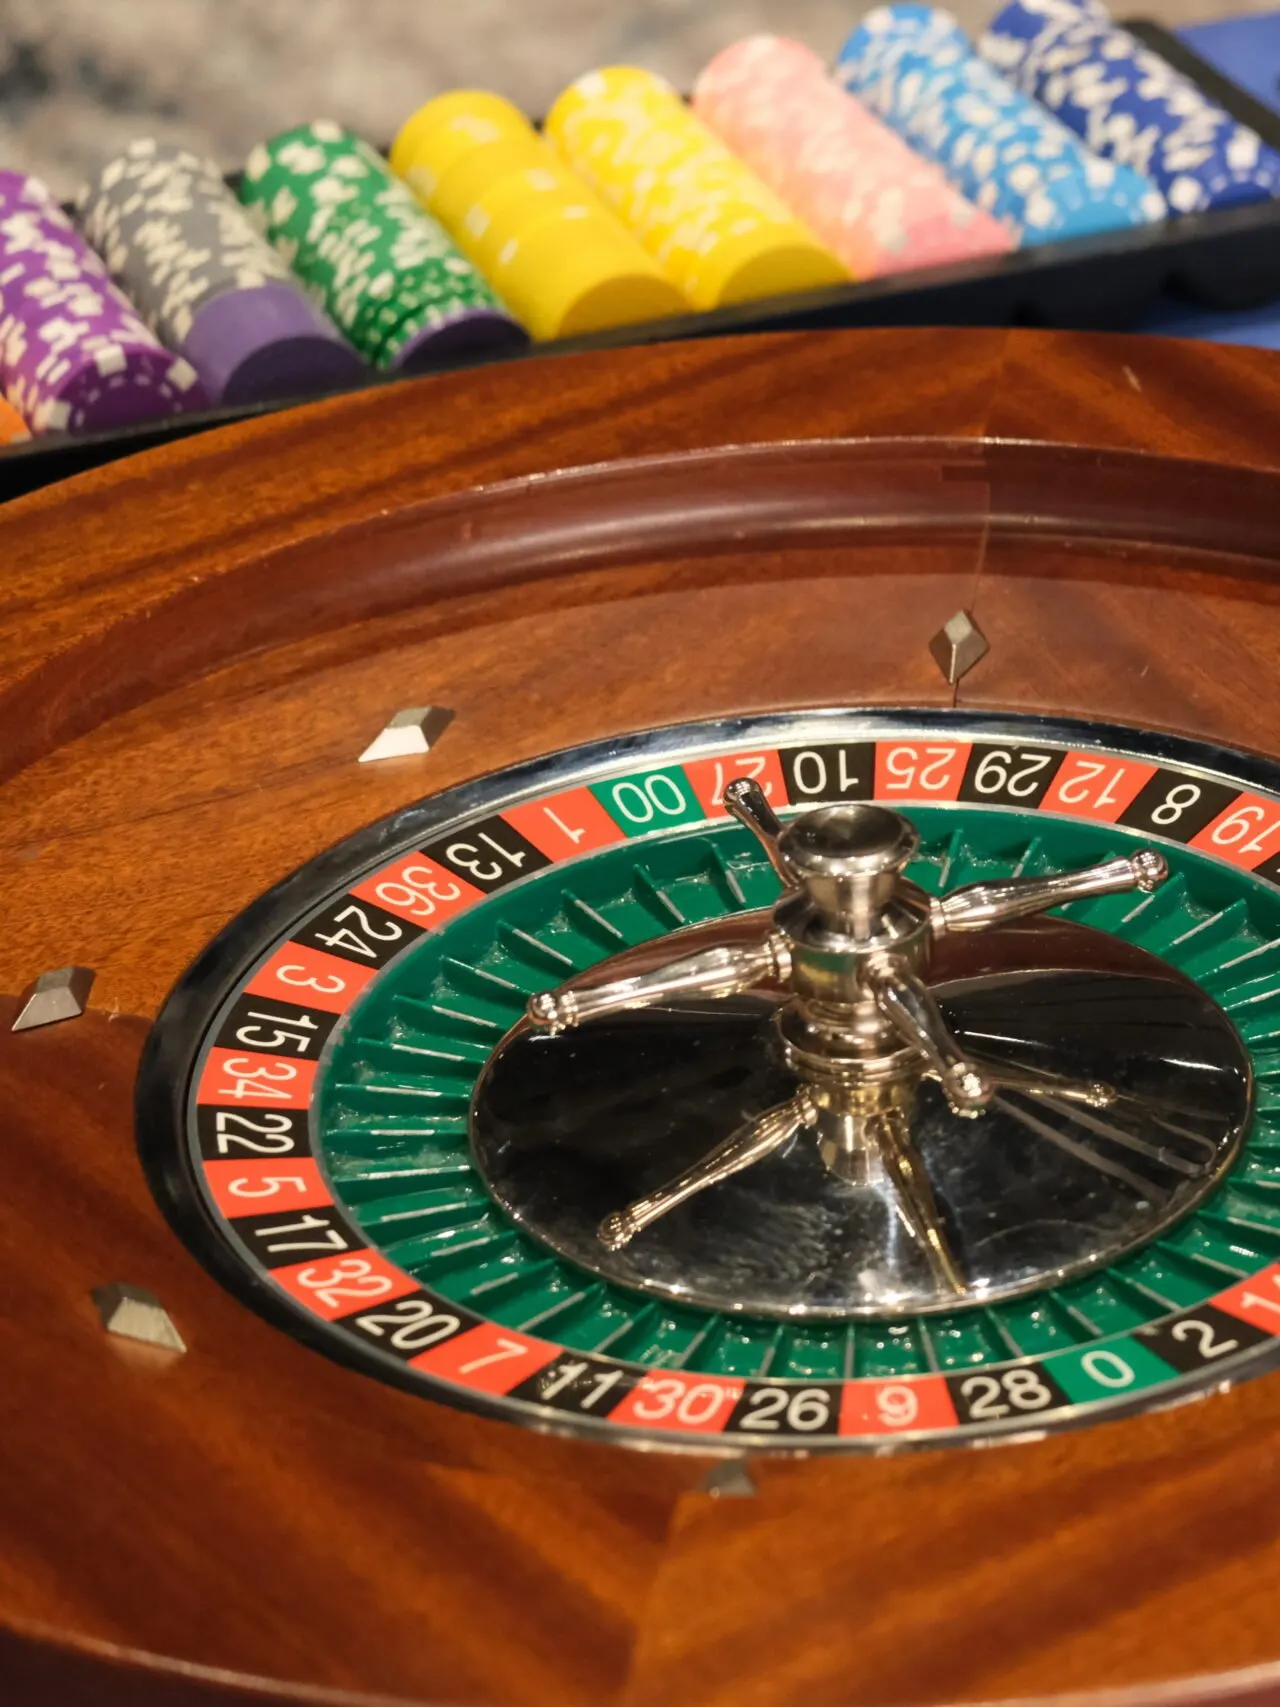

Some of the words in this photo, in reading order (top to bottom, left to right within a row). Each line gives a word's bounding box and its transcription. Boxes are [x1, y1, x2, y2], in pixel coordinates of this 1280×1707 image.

[792, 750, 859, 794] 10
[886, 746, 956, 790] 25
[974, 752, 1052, 797] 29
[1057, 760, 1126, 807] 12
[611, 773, 687, 823] 00
[1150, 783, 1200, 825] 8
[538, 806, 586, 845] 1
[445, 832, 527, 880] 13
[375, 866, 462, 917] 36
[315, 905, 403, 959] 24
[276, 964, 346, 994] 3
[235, 1011, 319, 1053] 15
[217, 1058, 297, 1100] 34
[215, 1112, 294, 1154] 22
[228, 1177, 306, 1198] 5
[254, 1214, 349, 1253] 17
[297, 1259, 393, 1307] 32
[355, 1300, 460, 1349] 20
[1172, 1320, 1238, 1359] 2
[459, 1339, 528, 1374] 7
[1081, 1350, 1136, 1388] 0
[541, 1361, 624, 1409] 11
[633, 1379, 724, 1423] 30
[876, 1385, 918, 1427] 9
[960, 1368, 1052, 1419] 28
[740, 1388, 829, 1431] 26
